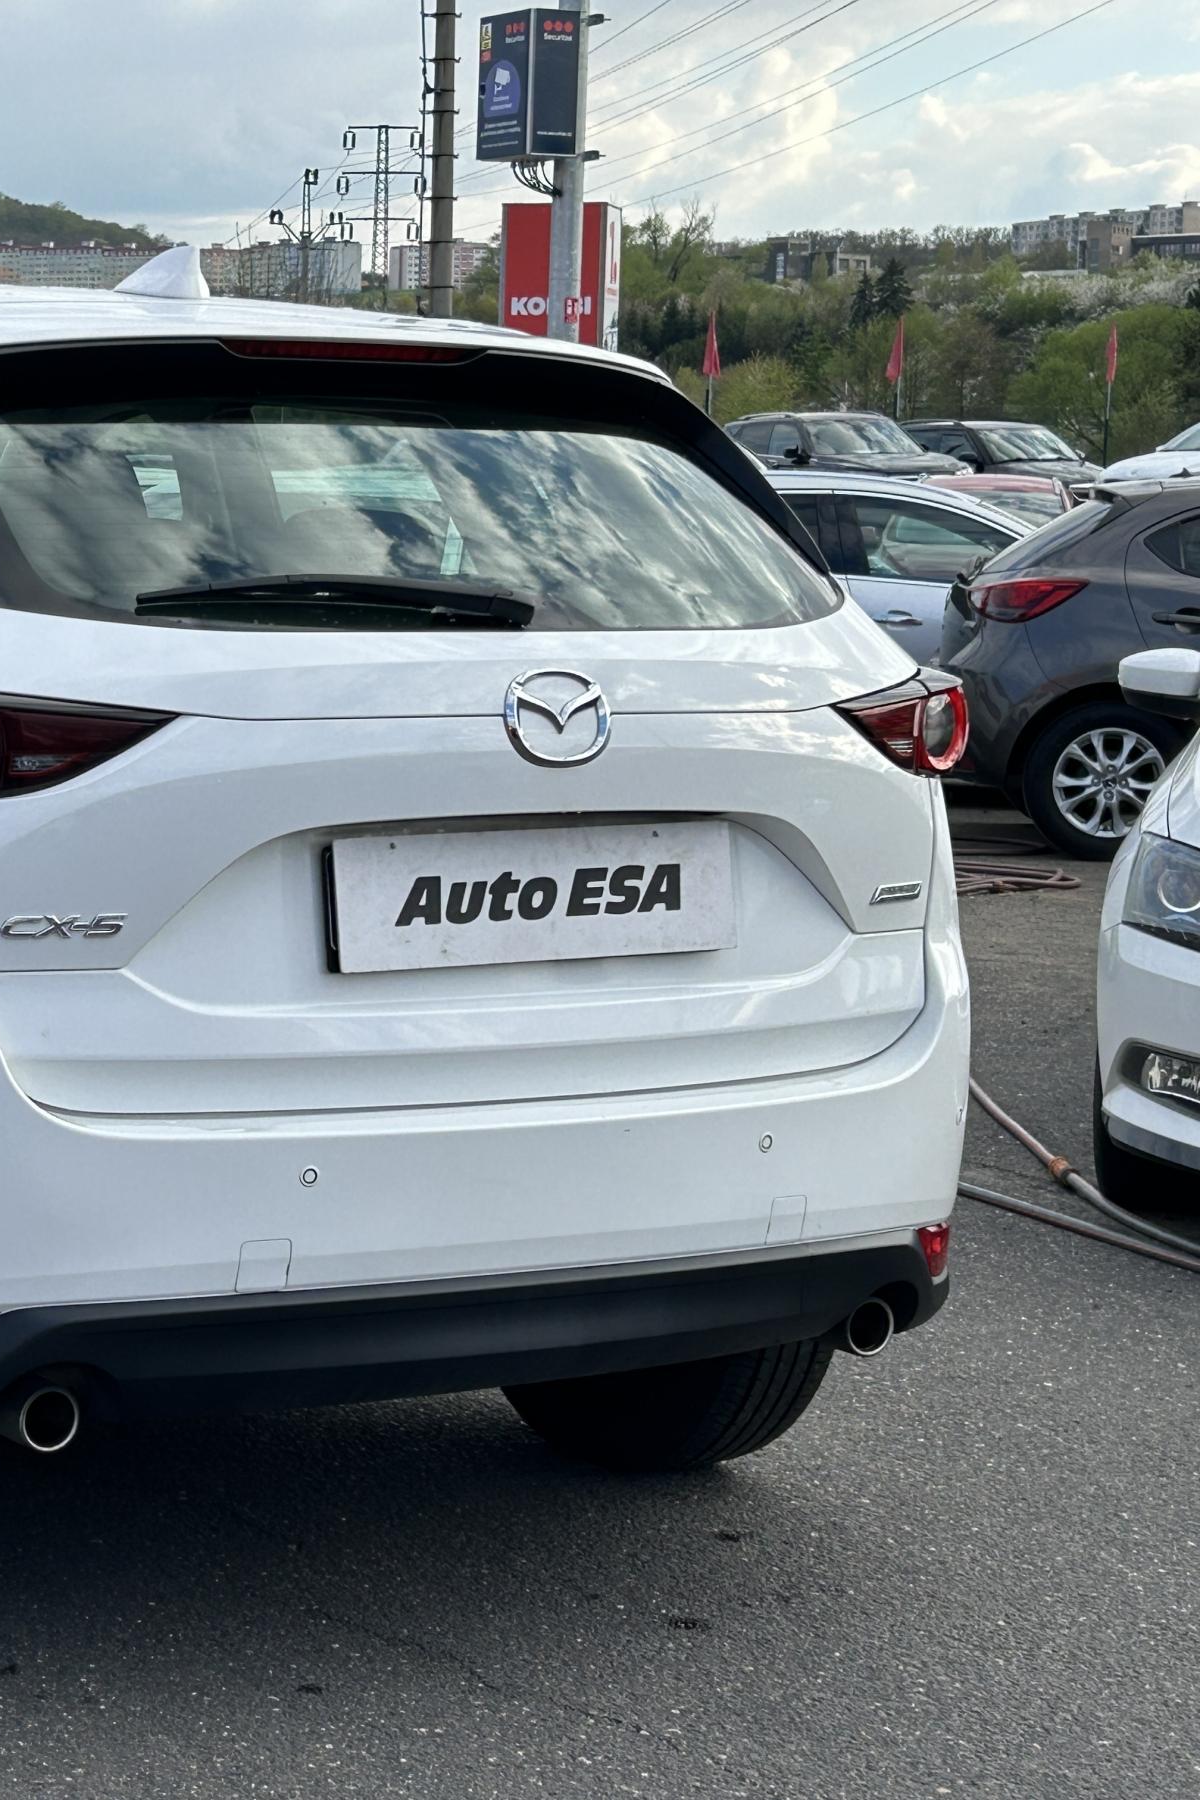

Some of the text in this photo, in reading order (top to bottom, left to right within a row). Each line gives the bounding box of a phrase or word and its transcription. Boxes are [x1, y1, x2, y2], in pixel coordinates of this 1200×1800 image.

[511, 296, 591, 316] KOI
[394, 863, 681, 927] Auto ESA
[0, 913, 129, 938] CX-5
